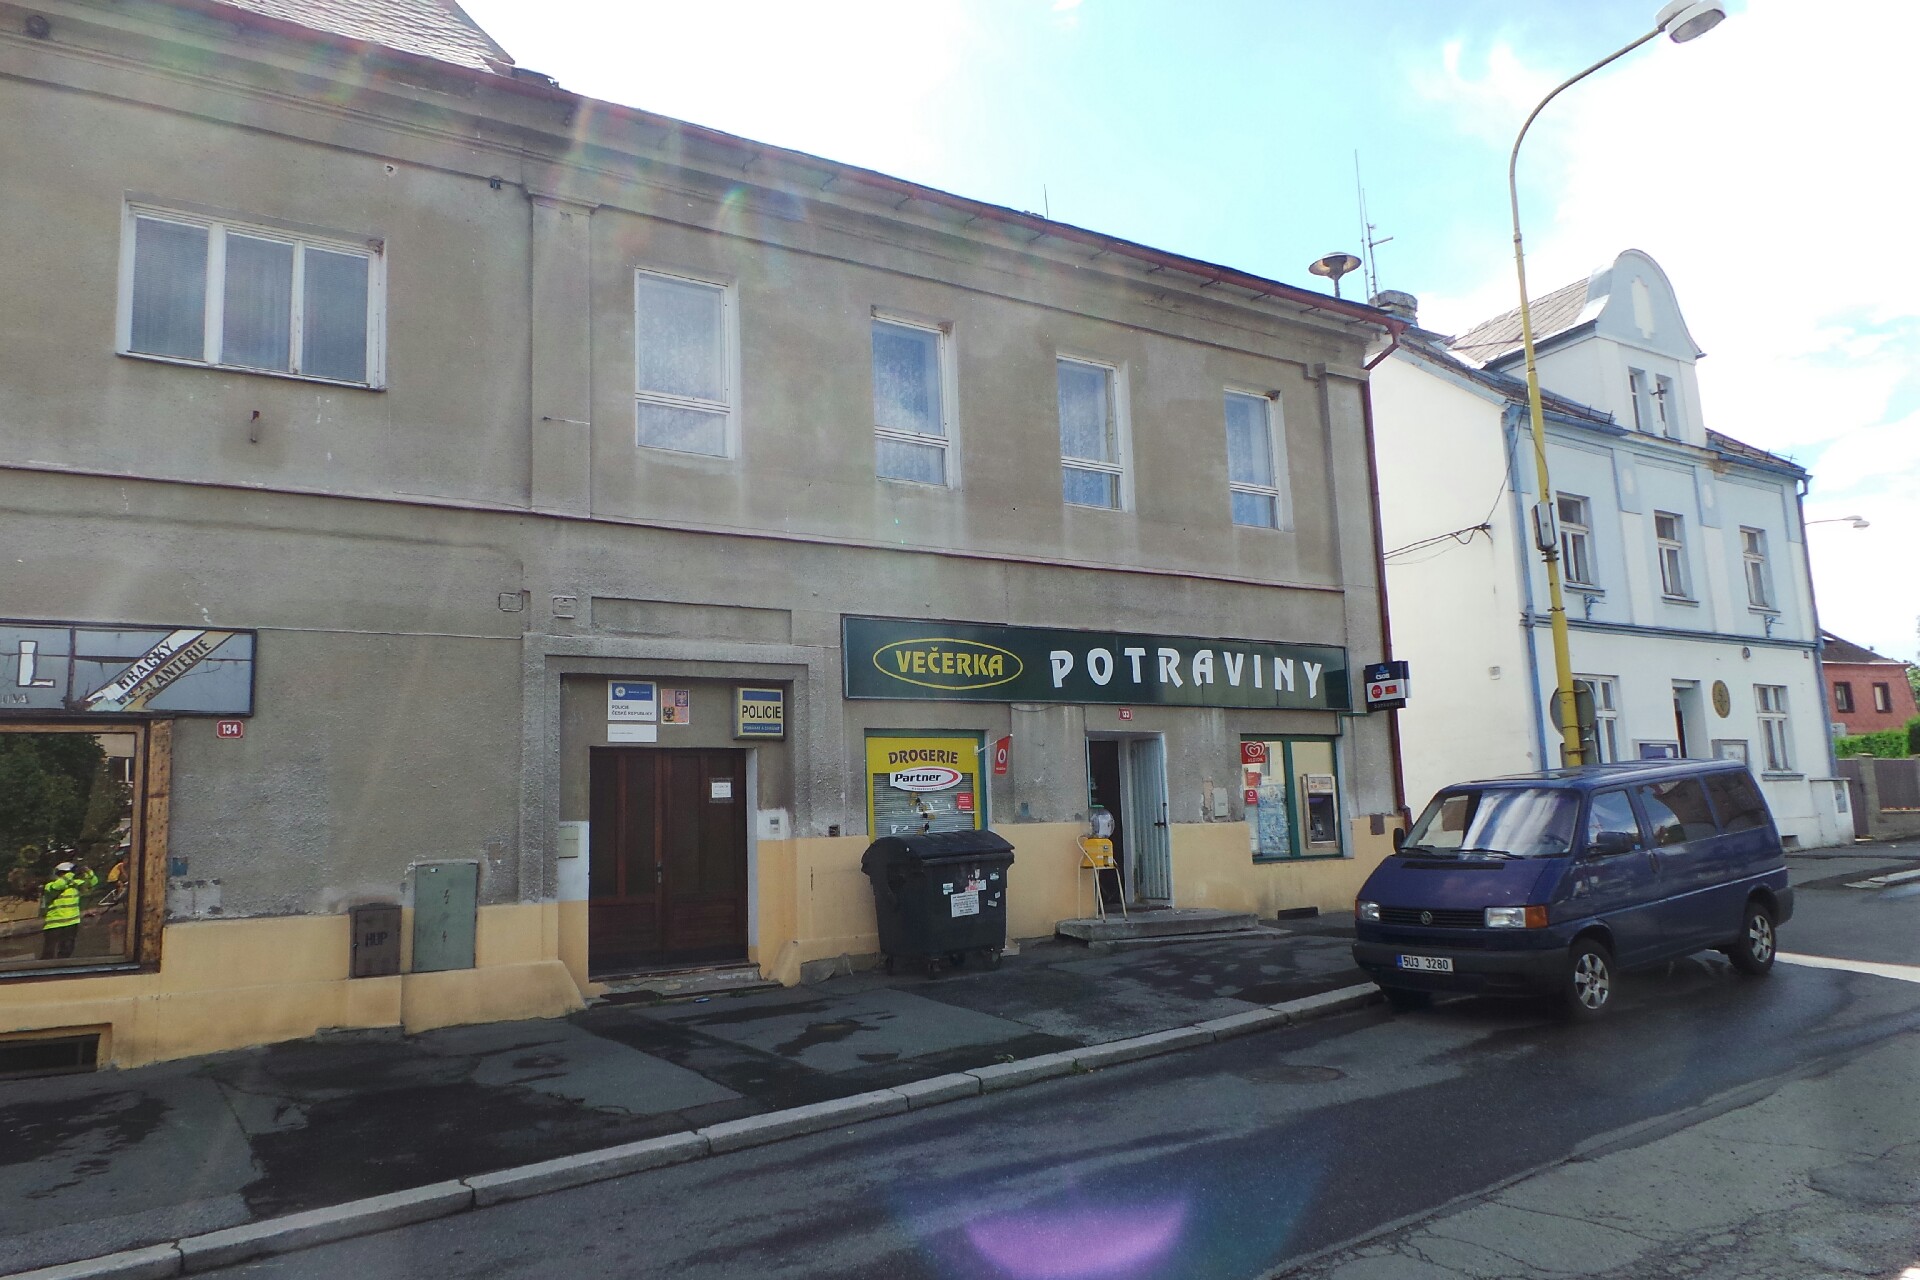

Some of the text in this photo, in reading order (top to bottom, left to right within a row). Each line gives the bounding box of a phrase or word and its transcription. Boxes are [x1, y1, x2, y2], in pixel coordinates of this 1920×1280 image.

[895, 646, 1003, 678] VEČERKA
[1050, 647, 1322, 699] POTRAVINY
[742, 704, 782, 719] POLICIE
[222, 724, 238, 735] 134
[888, 749, 959, 765] DROGERIE
[894, 773, 941, 783] Partner
